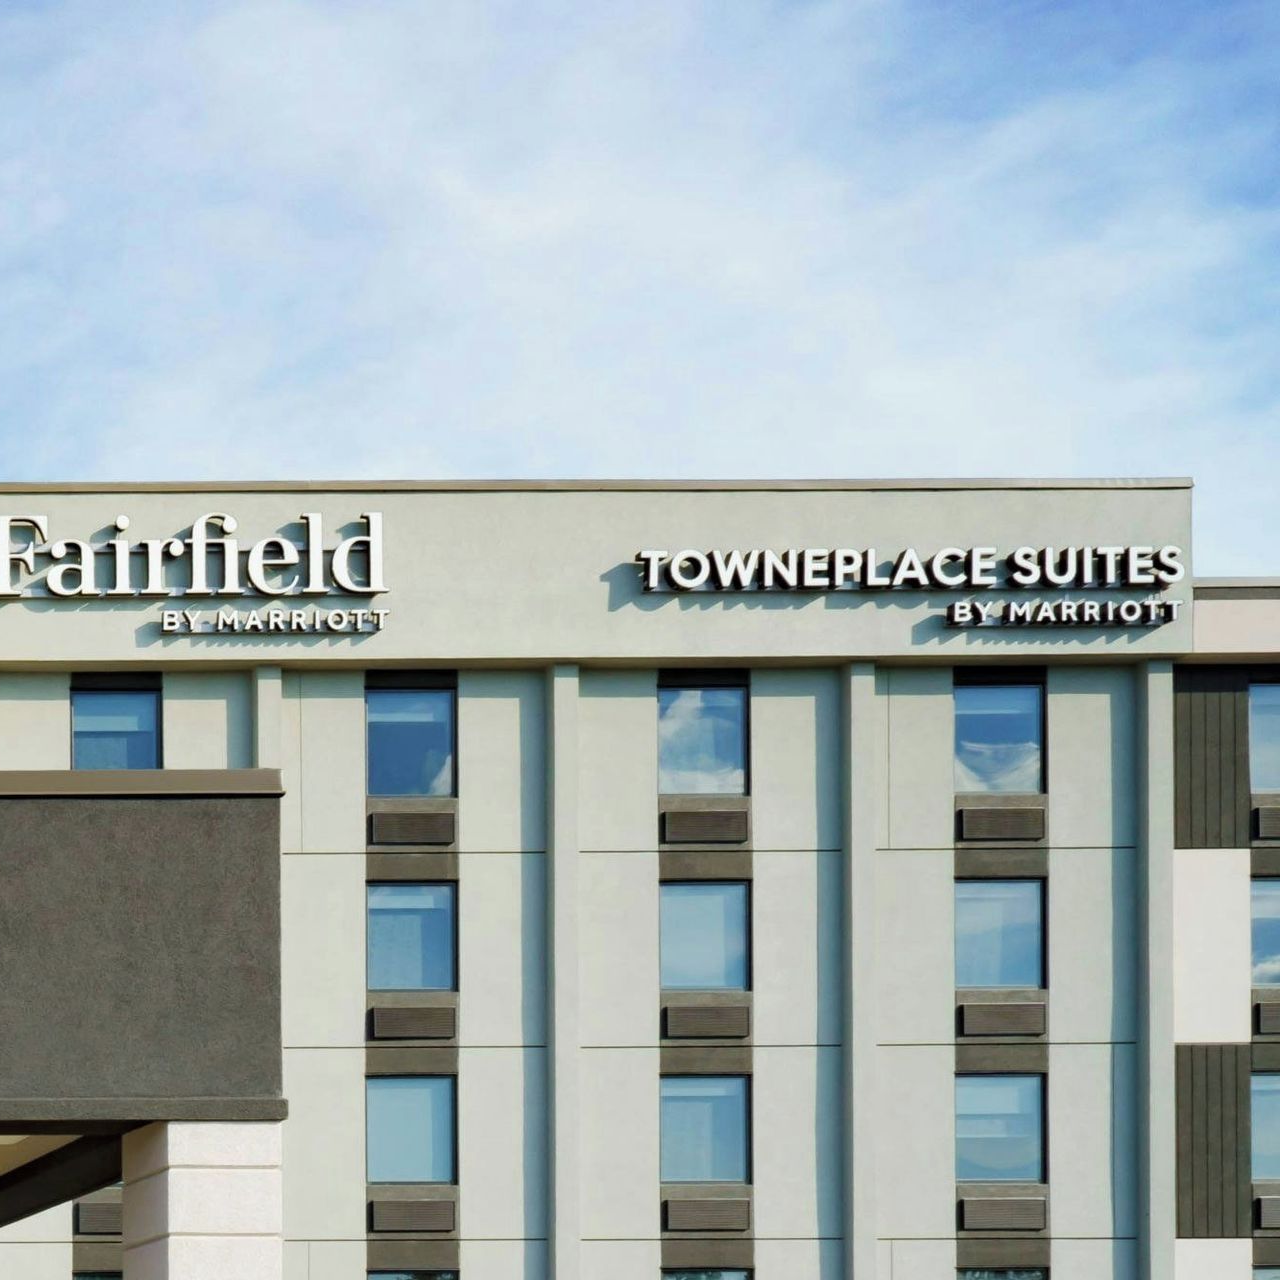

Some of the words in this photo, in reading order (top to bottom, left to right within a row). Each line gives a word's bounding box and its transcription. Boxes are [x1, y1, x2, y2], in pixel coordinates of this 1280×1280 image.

[642, 548, 998, 588] TOWNEPLACE
[1012, 546, 1184, 585] SUITES
[163, 610, 198, 632] BY
[219, 609, 389, 631] MARRIOTT
[953, 603, 993, 622] BY
[1009, 601, 1182, 621] MARRIOTT
